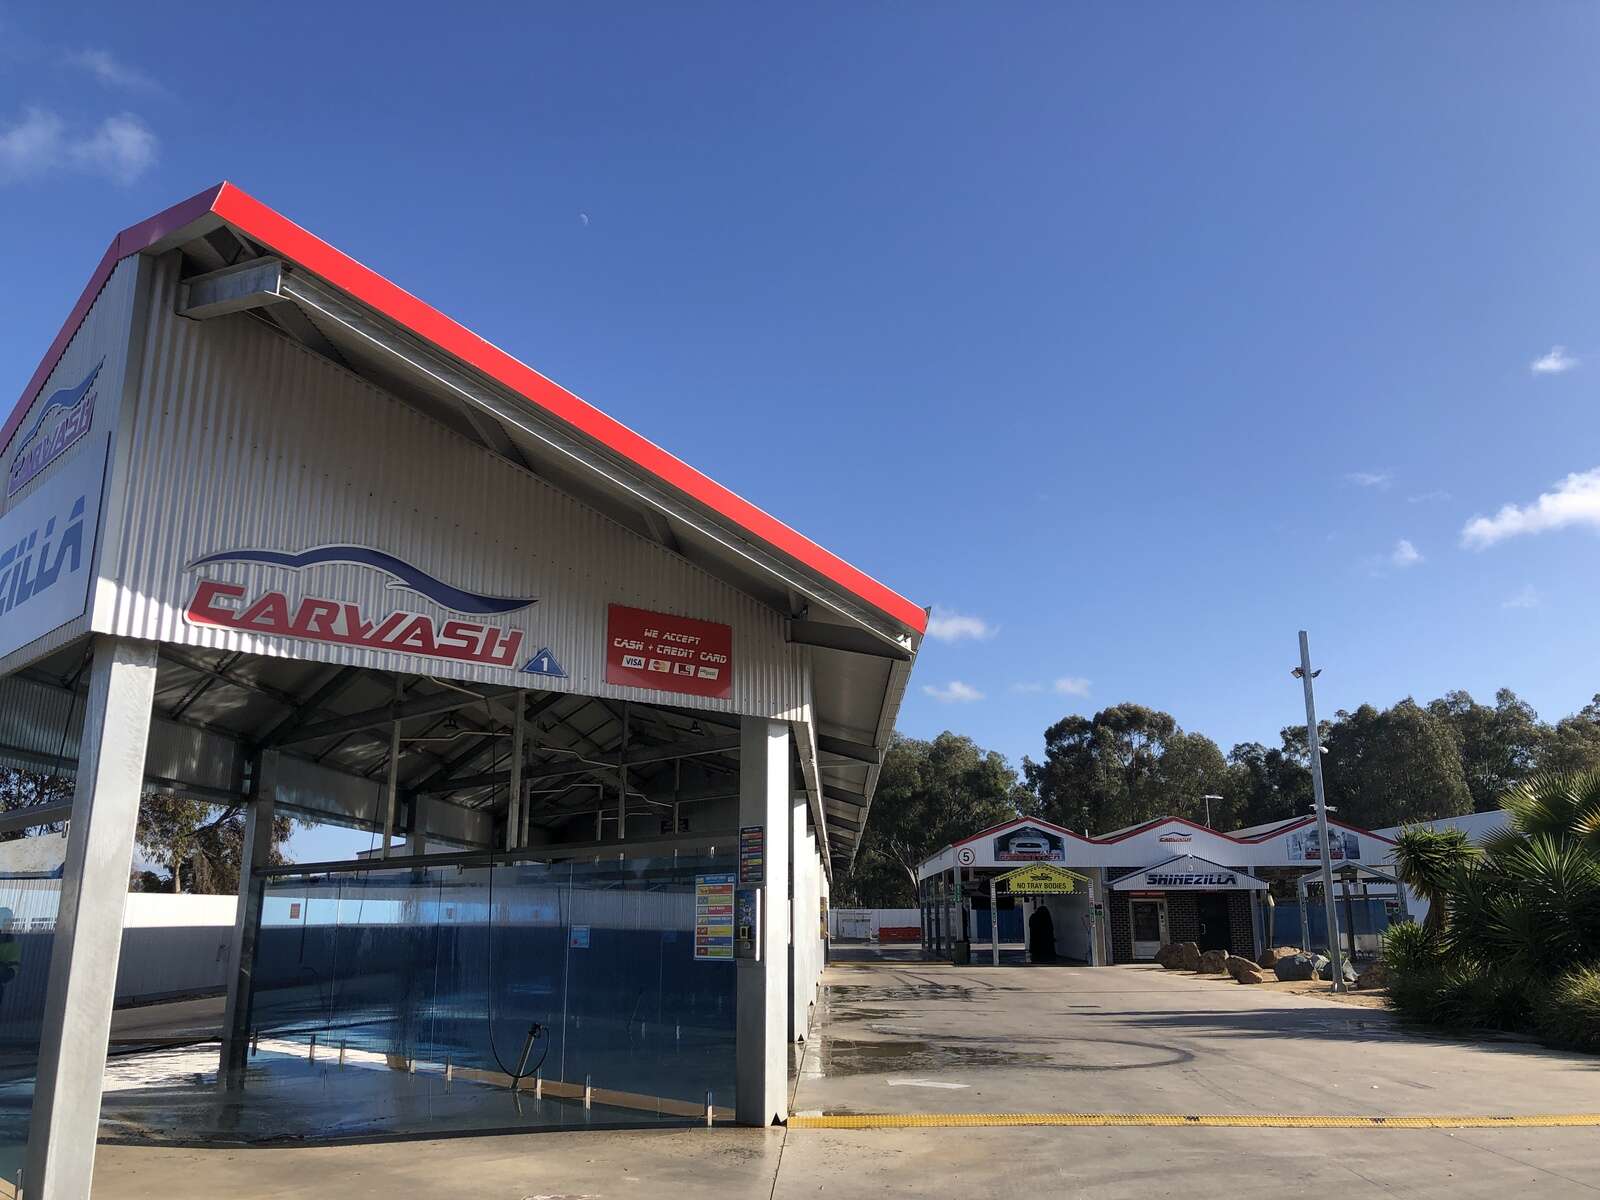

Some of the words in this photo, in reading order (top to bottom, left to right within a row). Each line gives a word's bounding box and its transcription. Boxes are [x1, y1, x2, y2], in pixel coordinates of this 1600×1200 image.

[8, 392, 97, 497] CARWASH
[186, 580, 525, 667] CARWASH
[644, 628, 658, 638] WE
[663, 632, 701, 645] ACCEPT
[614, 638, 644, 651] CASH
[657, 644, 695, 659] CREDIT
[700, 651, 727, 664] CARD
[541, 656, 548, 671] 1
[625, 657, 642, 666] VISA
[963, 852, 970, 862] 5
[1147, 874, 1236, 885] SHINEZILLA
